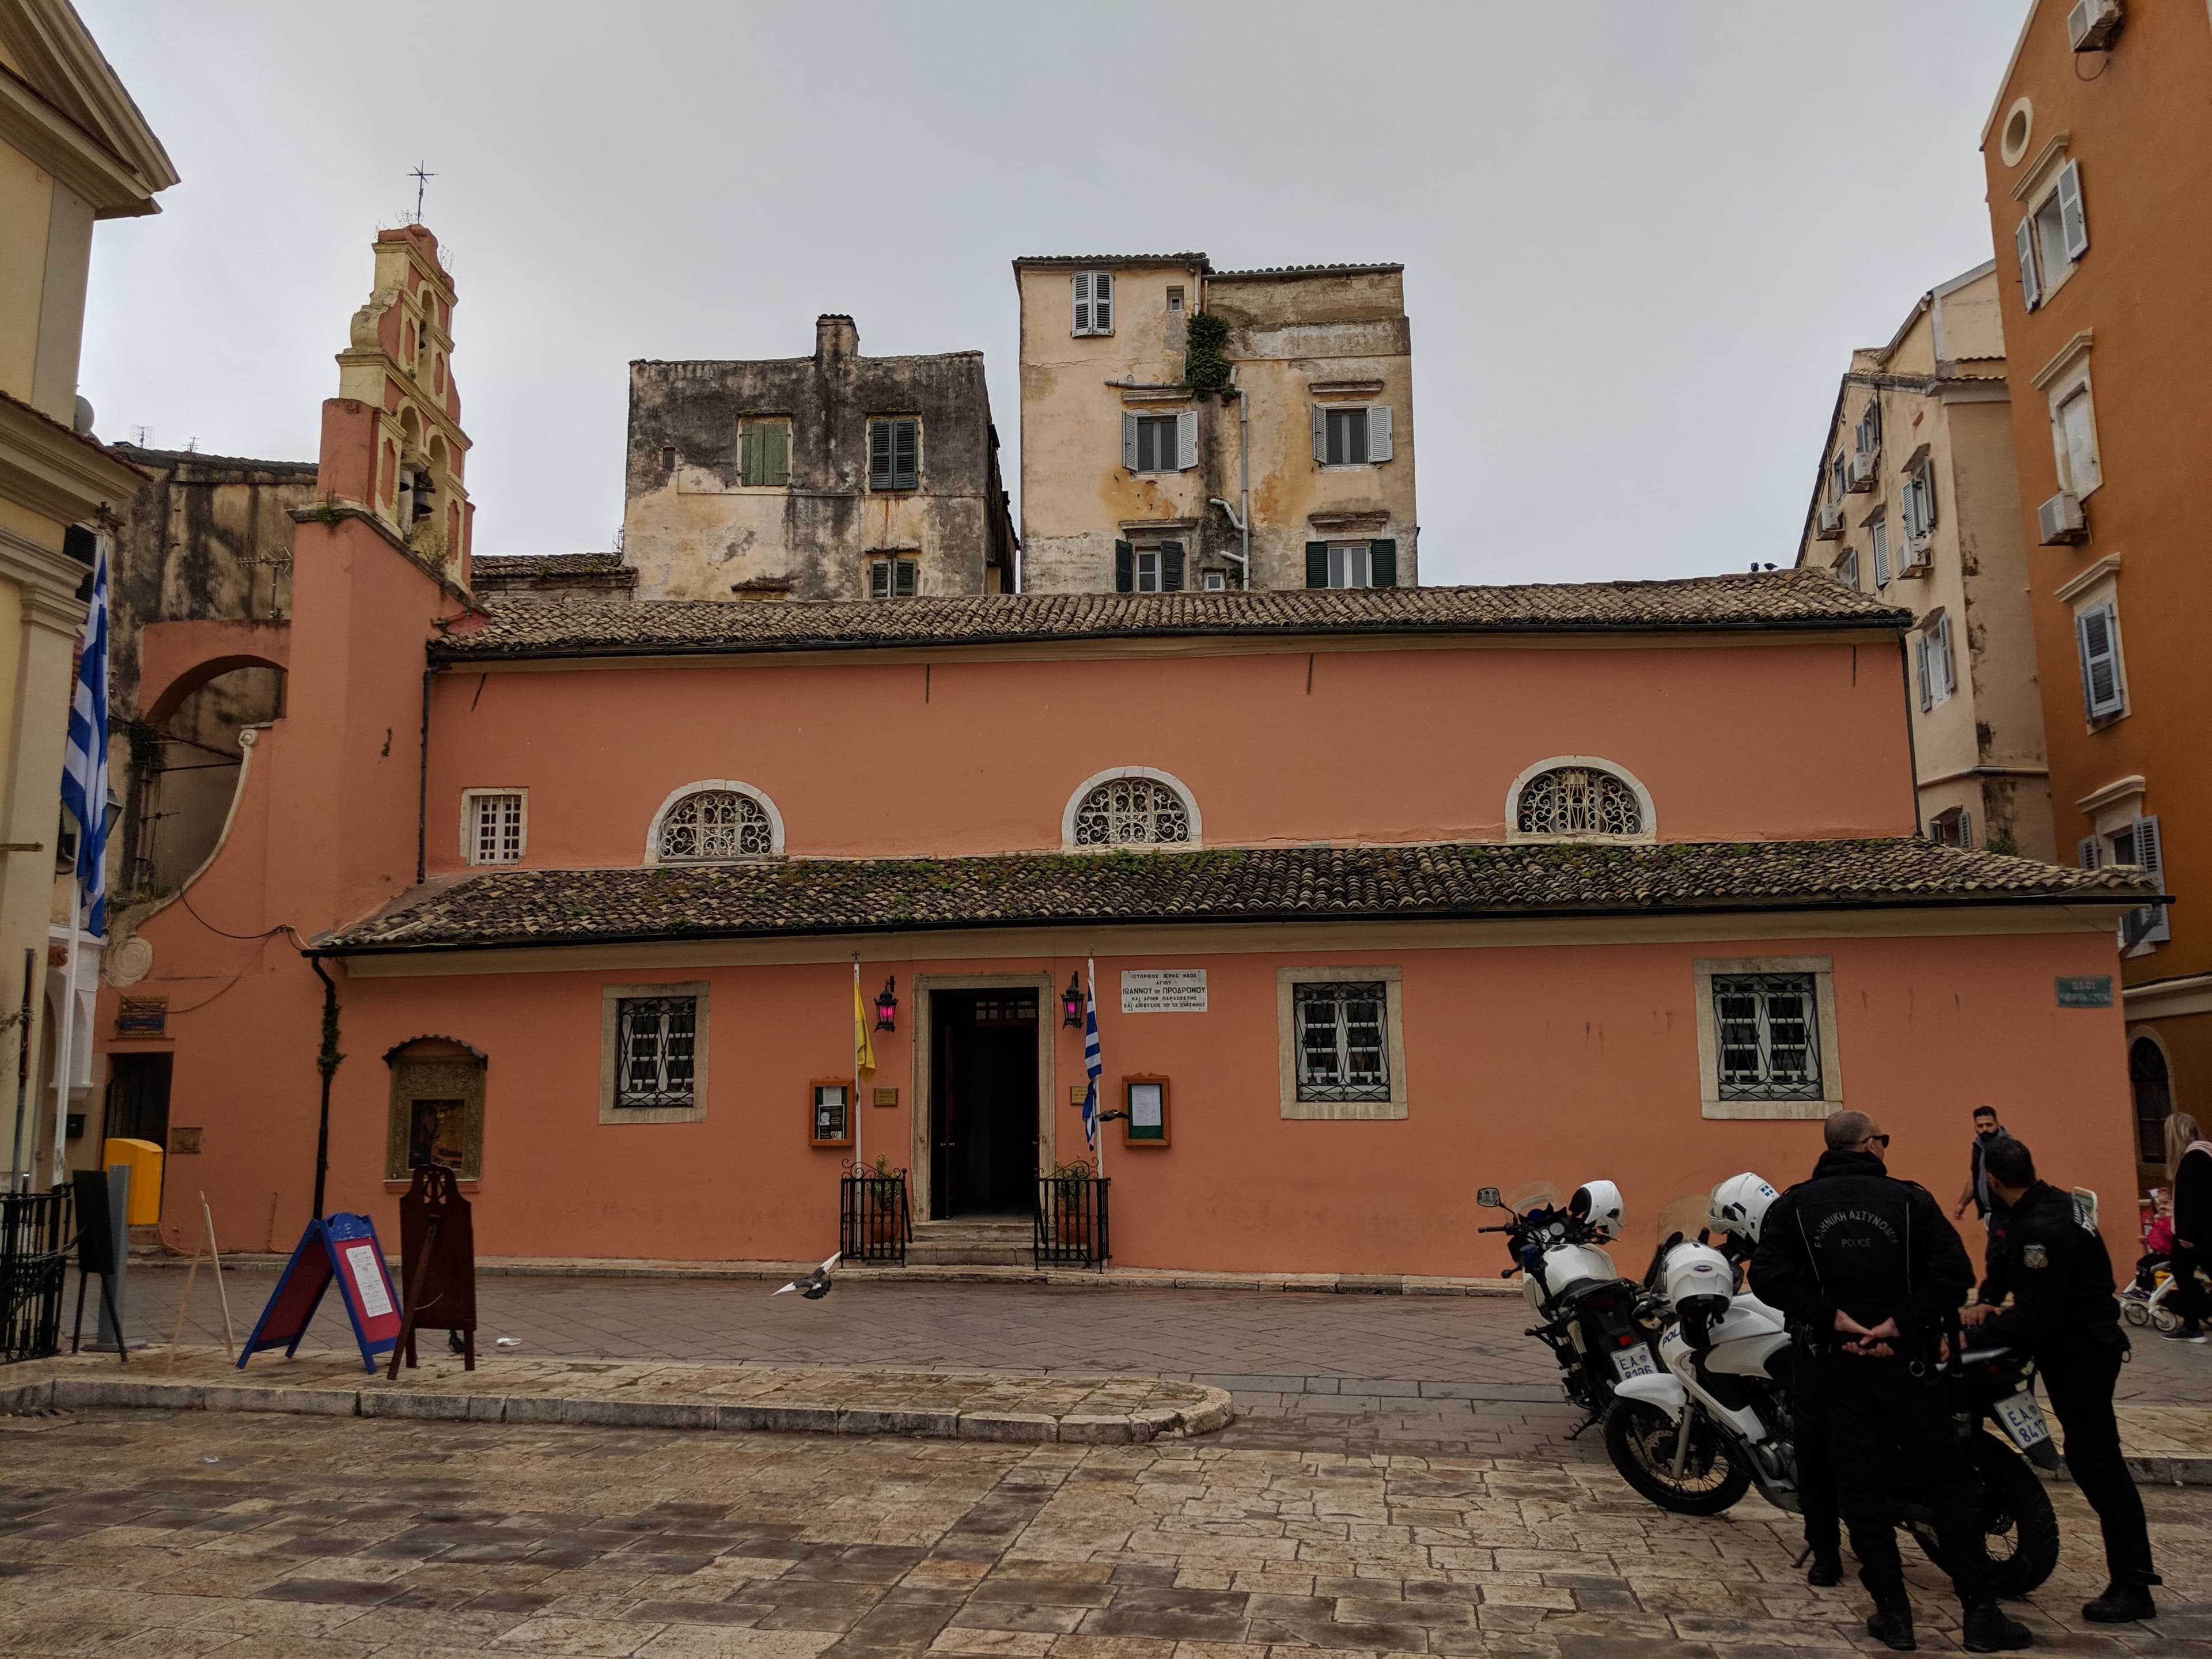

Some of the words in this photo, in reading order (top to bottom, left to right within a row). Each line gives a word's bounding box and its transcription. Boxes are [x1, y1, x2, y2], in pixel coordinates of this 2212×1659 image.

[1162, 986, 1206, 994] ΠΡΟΔΡΟΜΟΥ
[1841, 1238, 1872, 1248] POLICE
[2019, 1419, 2048, 1442] 8417
